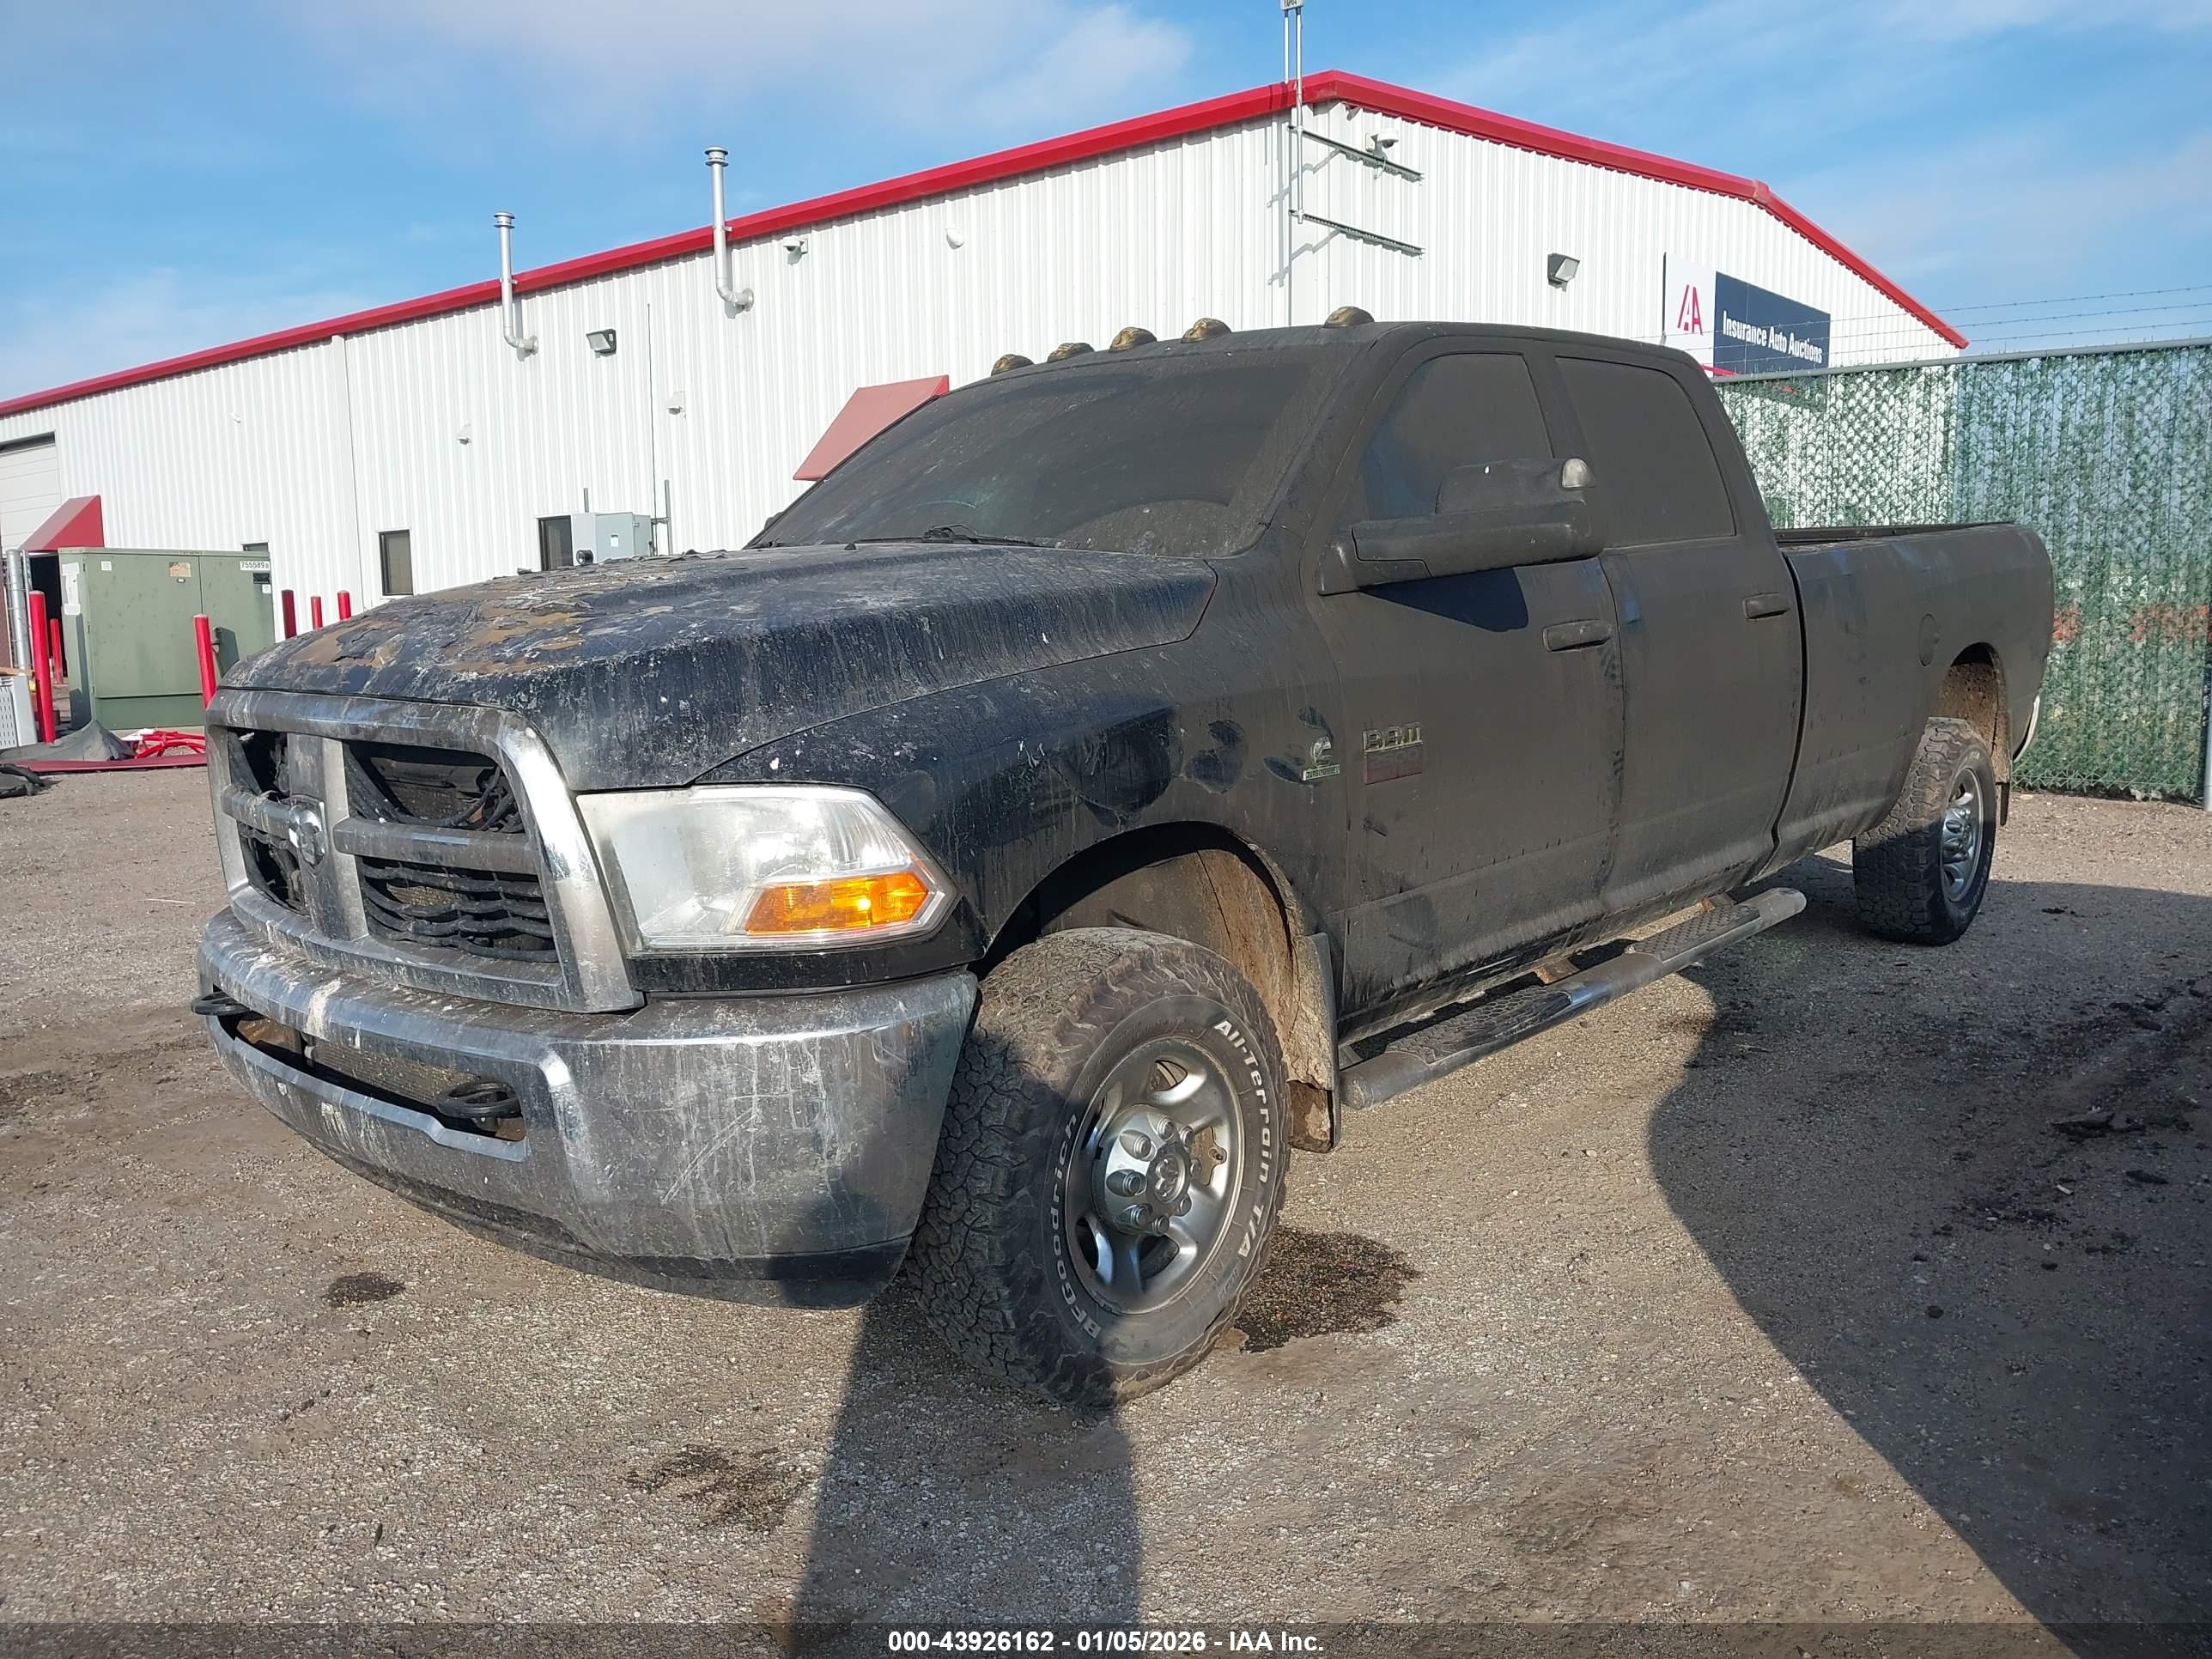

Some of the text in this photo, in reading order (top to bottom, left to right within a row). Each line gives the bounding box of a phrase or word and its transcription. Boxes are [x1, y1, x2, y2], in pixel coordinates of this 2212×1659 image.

[1723, 310, 1822, 364] Insurance Auto Auctions
[1050, 1114, 1102, 1339] BFGoodrich
[1214, 1019, 1273, 1258] All-Terrain T/A
